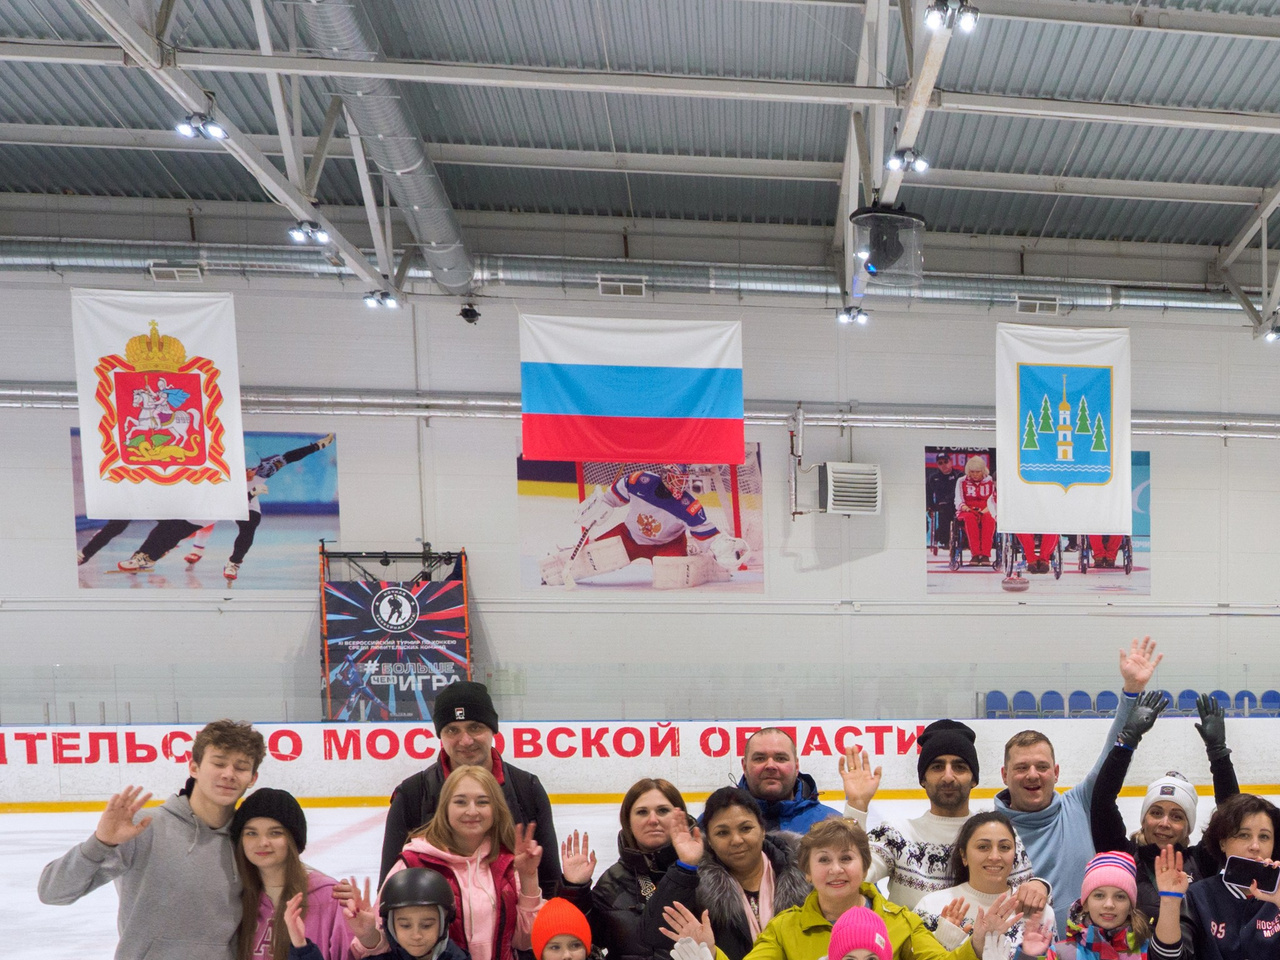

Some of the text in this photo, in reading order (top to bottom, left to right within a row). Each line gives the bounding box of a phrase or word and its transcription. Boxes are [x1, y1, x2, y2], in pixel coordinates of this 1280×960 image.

[0, 729, 303, 765] ТЕЛЬСО
[324, 722, 680, 761] МОСВСКОЙ
[1210, 920, 1226, 939] 95
